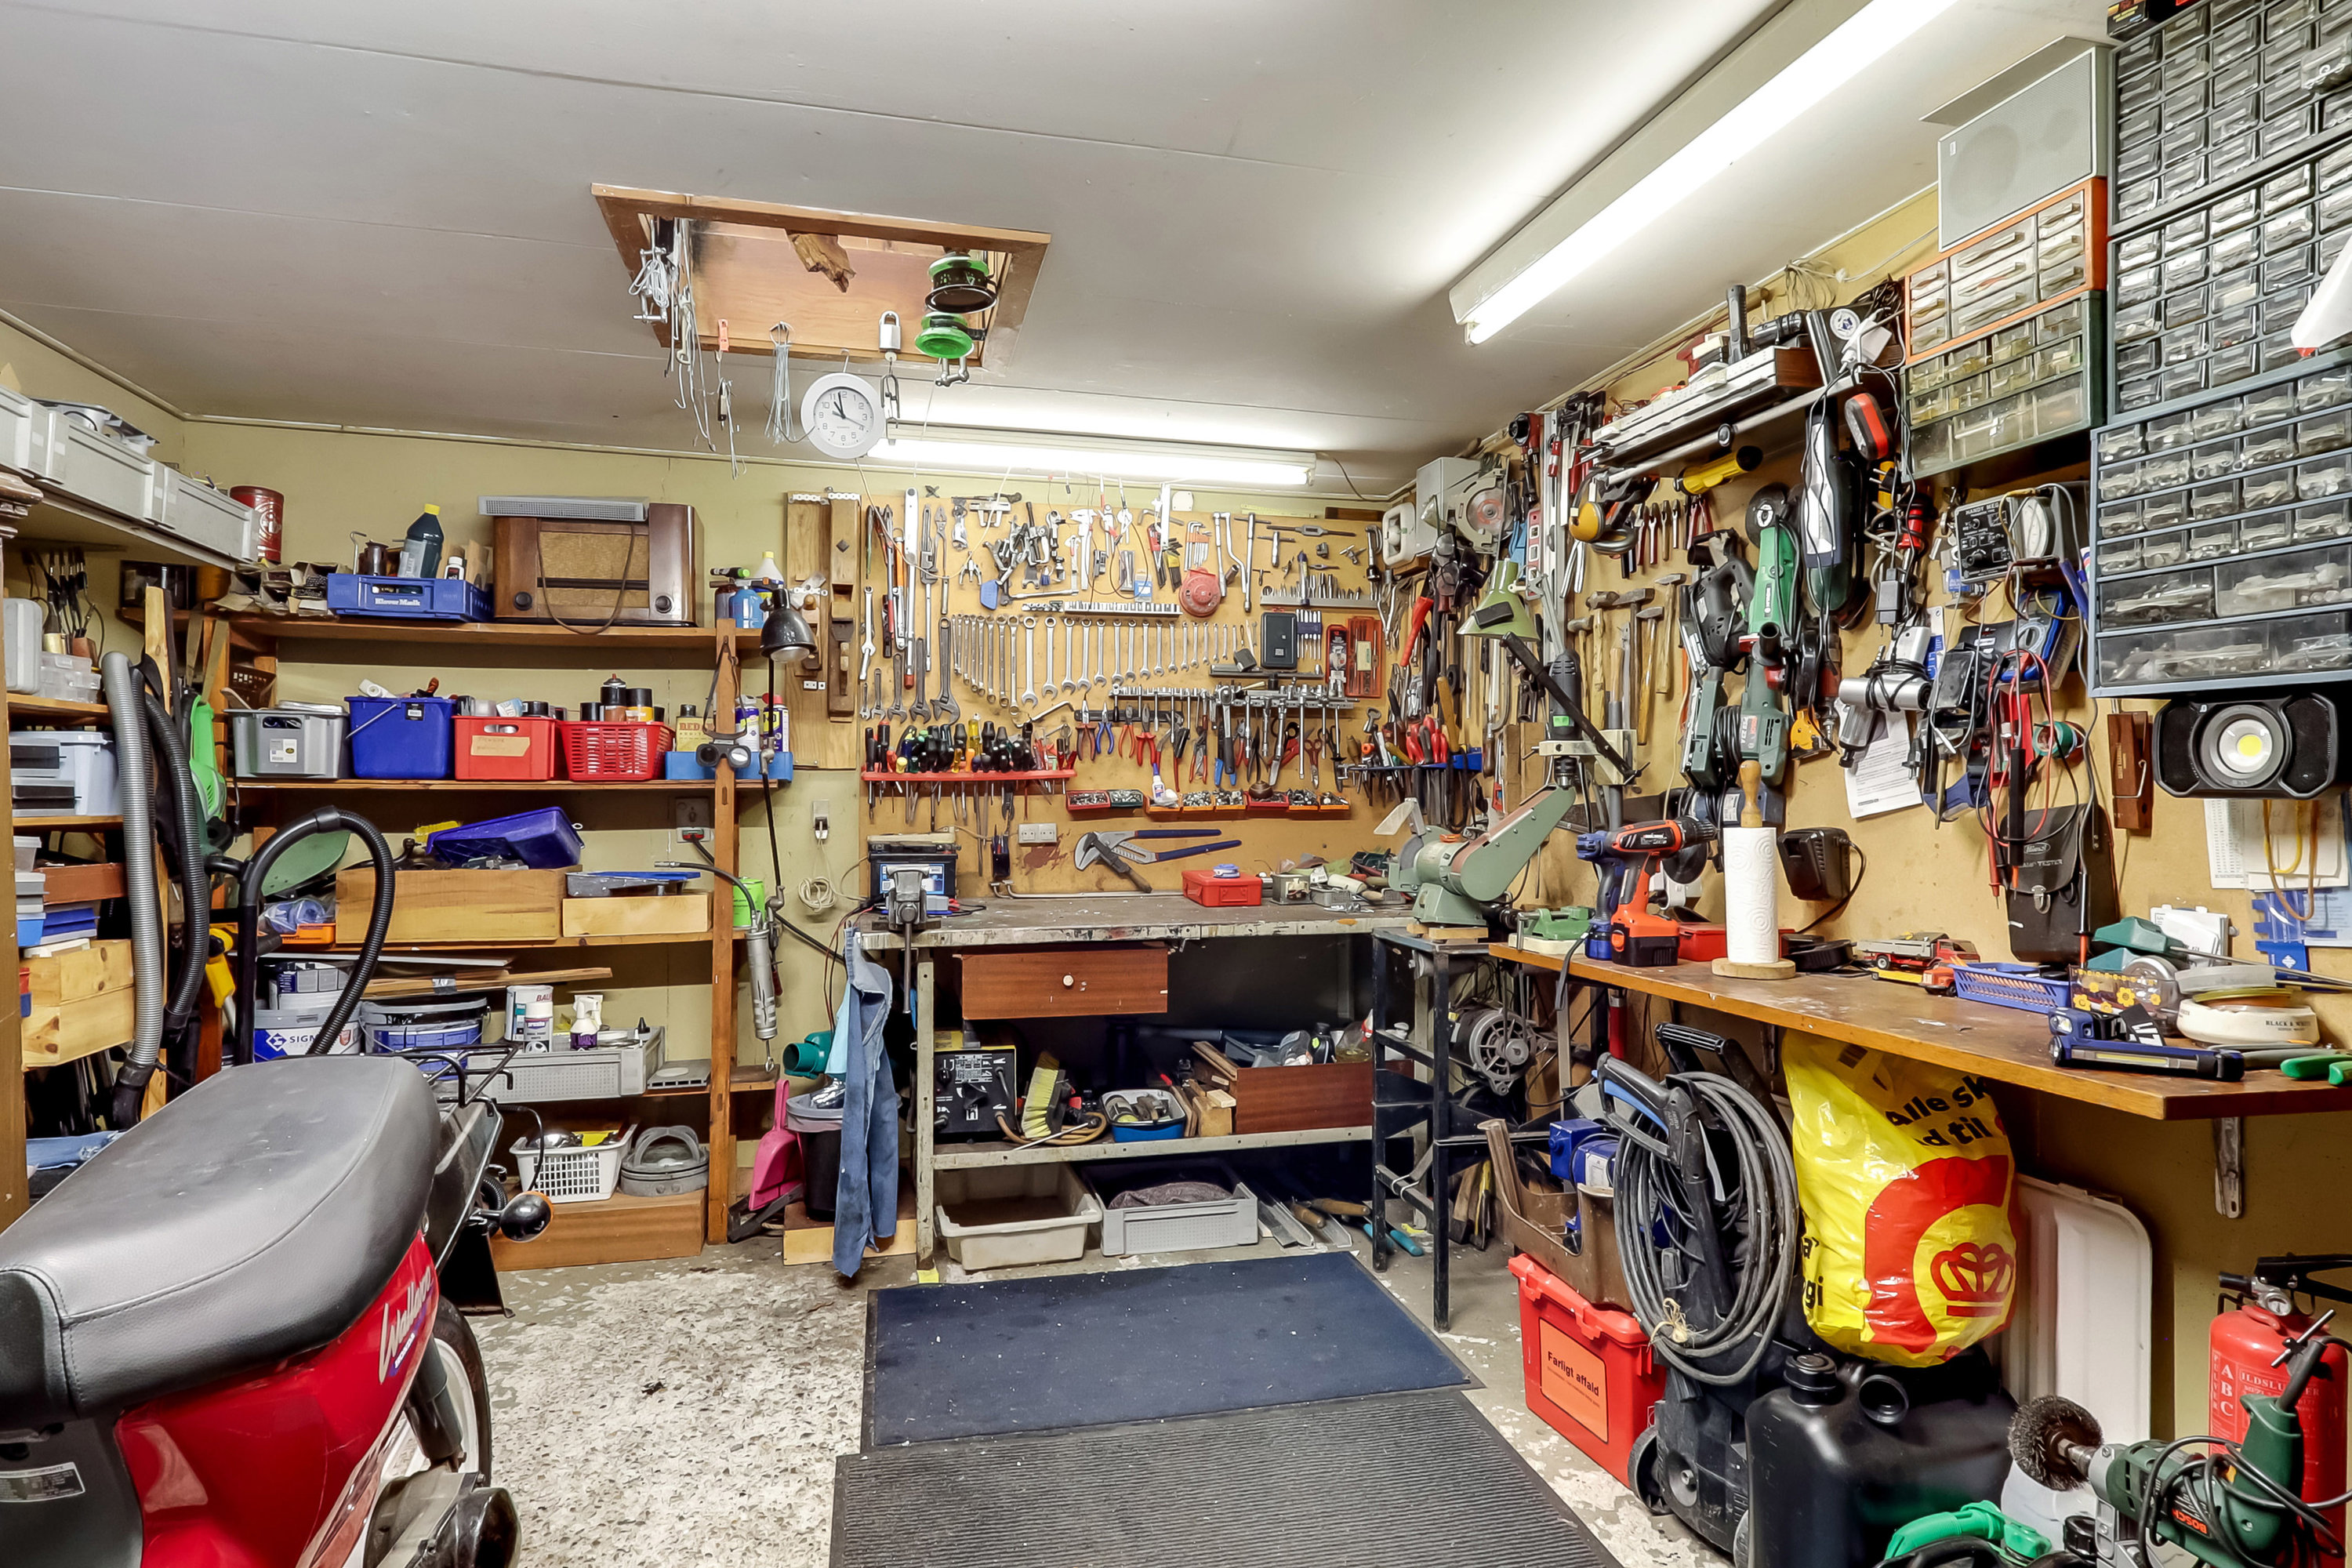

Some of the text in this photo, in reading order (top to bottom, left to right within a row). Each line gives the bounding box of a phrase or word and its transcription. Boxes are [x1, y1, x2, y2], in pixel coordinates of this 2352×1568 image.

[1965, 506, 1984, 515] HANDY
[1885, 1096, 1951, 1127] Alle
[1913, 1116, 1993, 1146] d til
[1548, 1351, 1574, 1378] Farligt
[1576, 1374, 1599, 1397] affald
[2241, 1372, 2320, 1396] ILDSLUER
